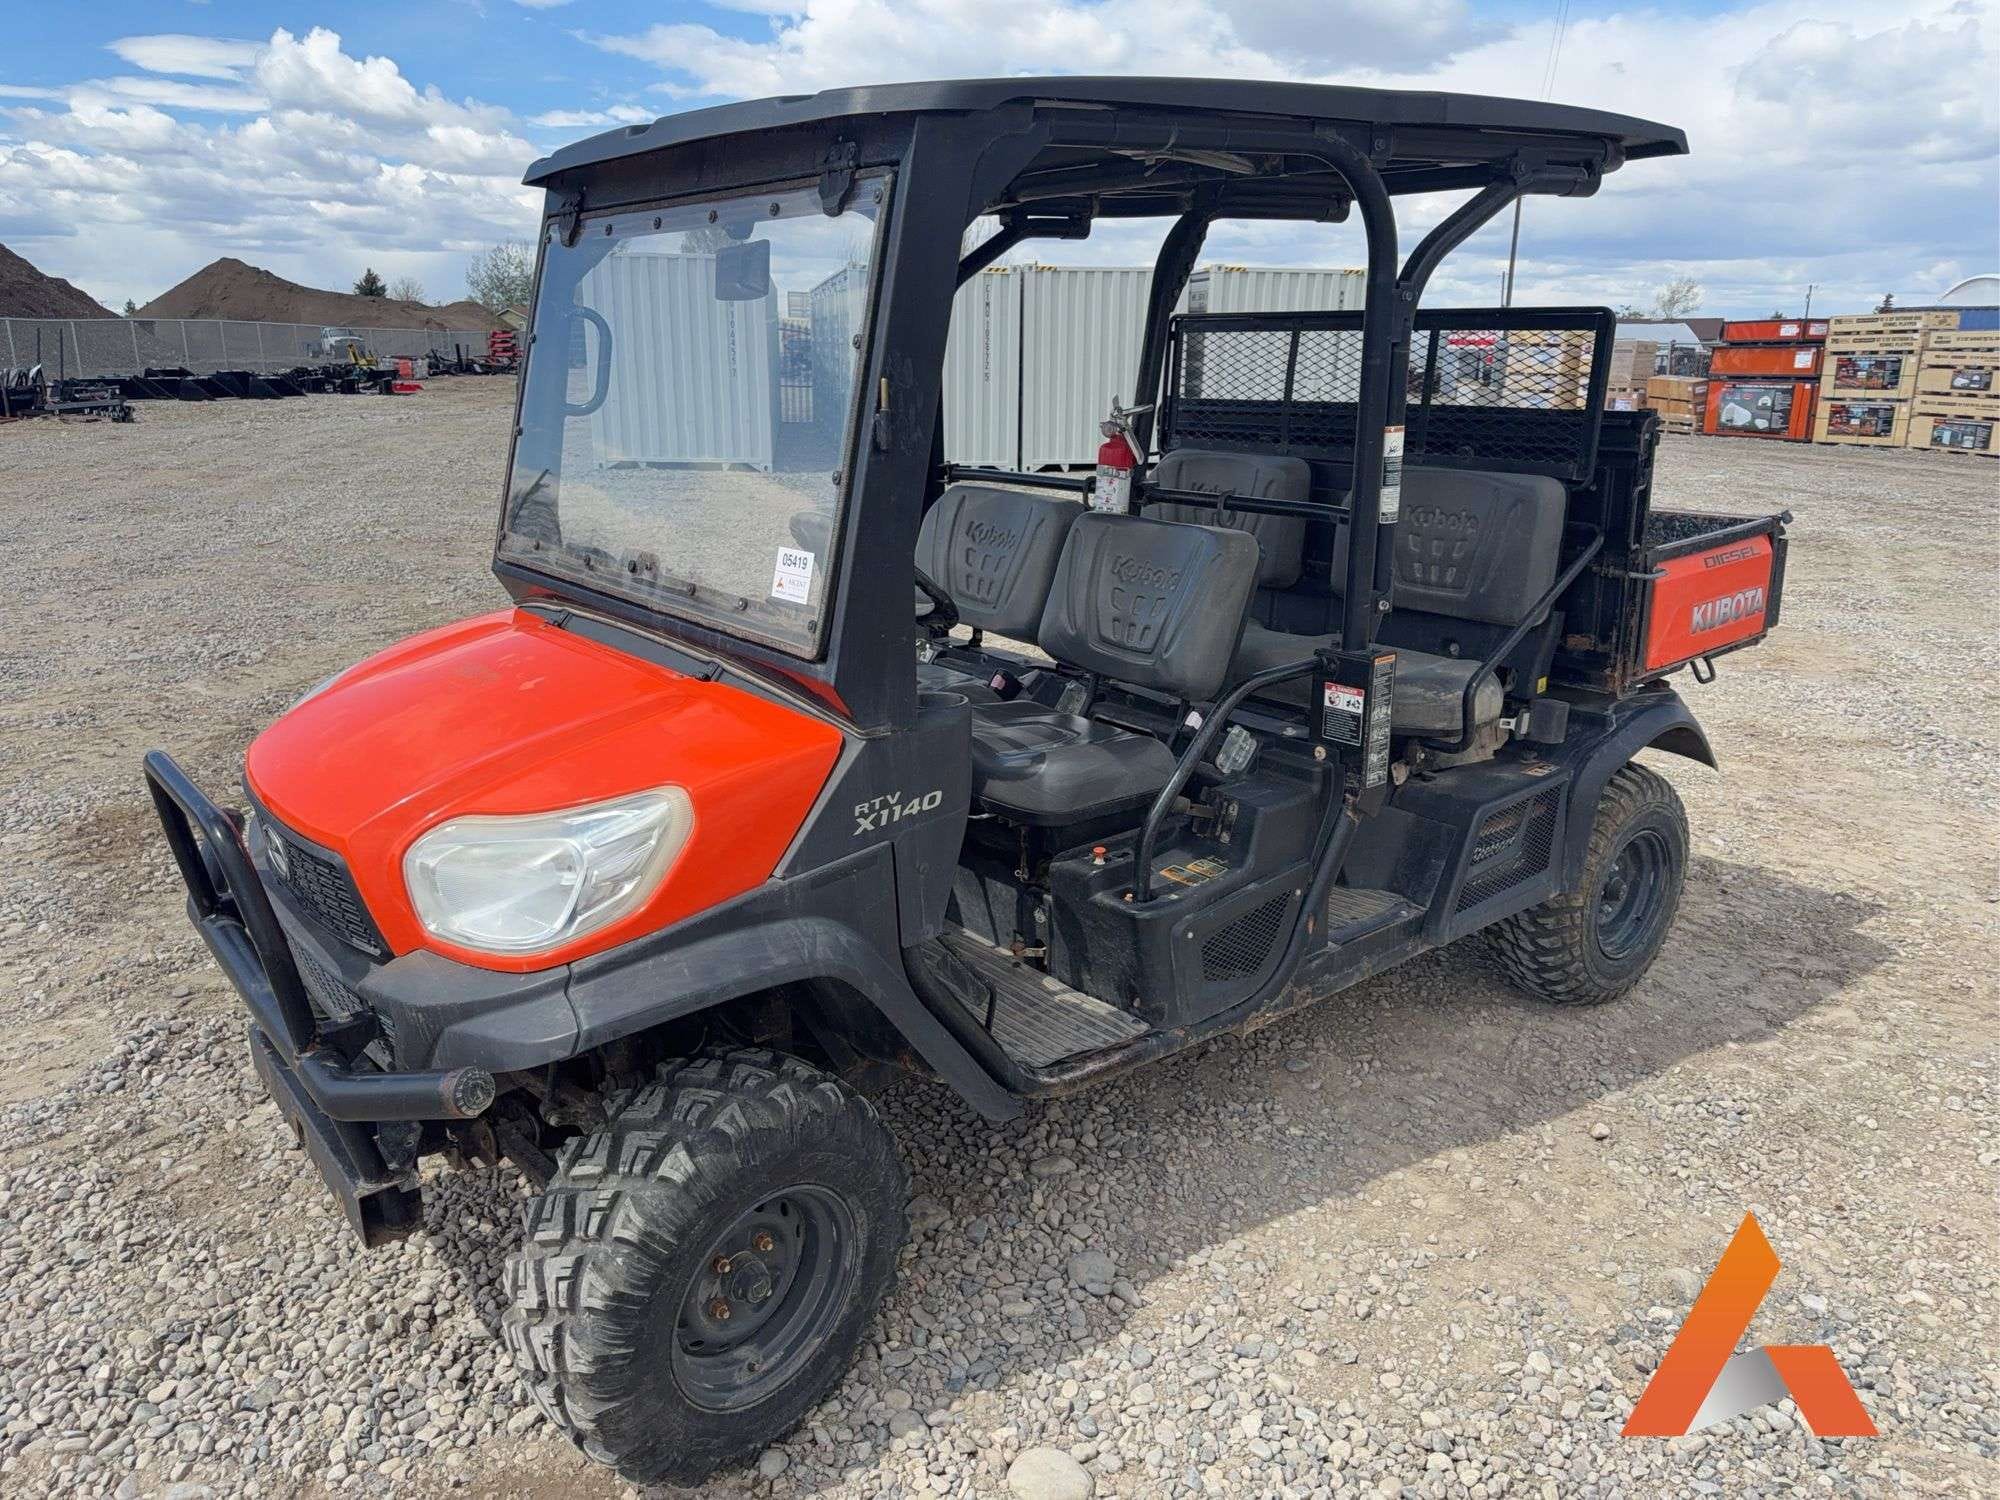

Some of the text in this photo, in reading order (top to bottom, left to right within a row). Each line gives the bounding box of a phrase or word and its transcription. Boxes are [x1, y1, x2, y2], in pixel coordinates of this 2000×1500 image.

[782, 552, 808, 570] 05419
[1703, 547, 1762, 569] DIESEL
[1690, 587, 1764, 635] KUBOTA
[852, 790, 943, 836] X1140
[854, 791, 901, 817] RTV
